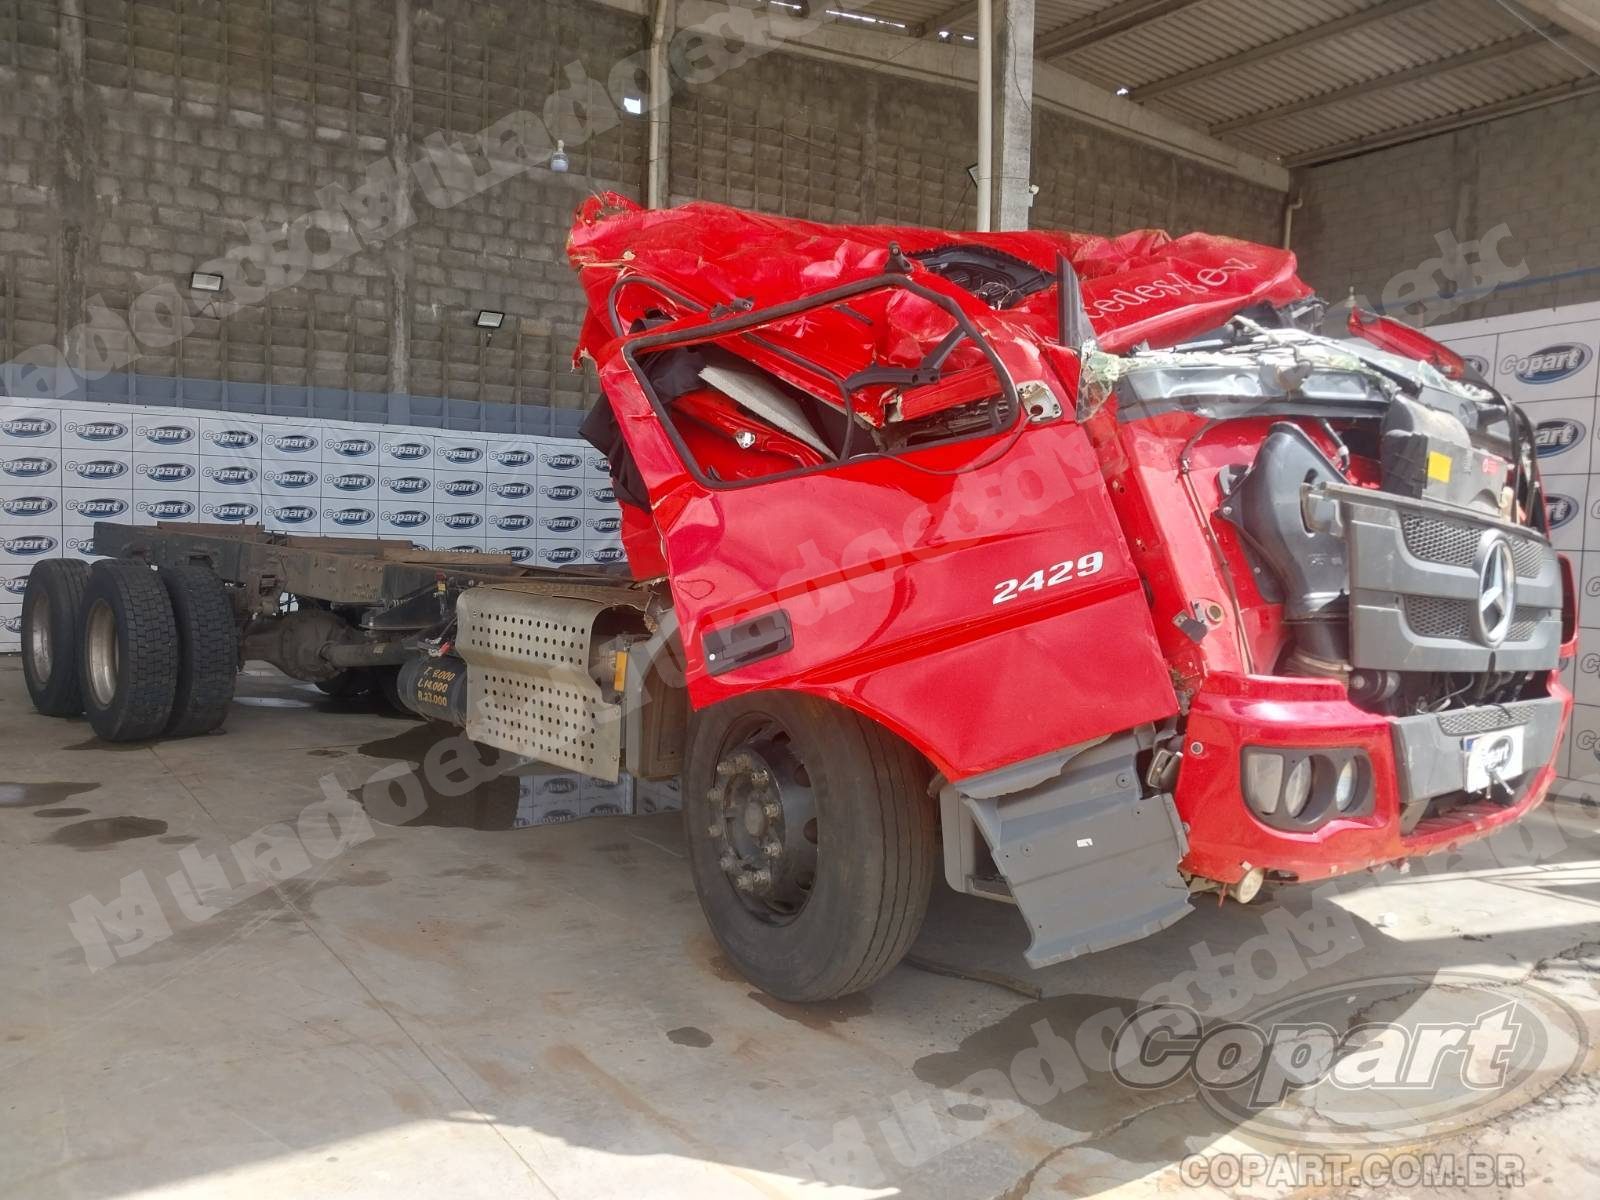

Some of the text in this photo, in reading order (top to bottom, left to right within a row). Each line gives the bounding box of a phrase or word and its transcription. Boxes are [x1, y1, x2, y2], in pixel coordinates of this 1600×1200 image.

[1500, 345, 1582, 378] Copart
[0, 420, 48, 433] opart
[65, 421, 121, 436] Copart
[136, 425, 188, 440] Copart
[202, 430, 251, 443] Copart
[1535, 423, 1575, 446] art
[264, 435, 312, 448] Copart
[324, 439, 368, 451] Copart
[382, 443, 425, 455] Copart
[437, 447, 477, 459] Copart
[489, 451, 528, 463] Copart
[540, 454, 577, 466] Copart
[587, 456, 609, 468] Cop
[0, 459, 49, 472] opart
[65, 461, 121, 473] Copart
[136, 463, 188, 477] Copart
[202, 467, 251, 480] Copart
[264, 471, 311, 484] Copart
[324, 474, 367, 486] Copart
[381, 477, 424, 489] Copart
[437, 480, 477, 492] Copart
[489, 483, 528, 495] Copart
[540, 486, 577, 498] Copart
[587, 488, 614, 499] Copa
[0, 499, 49, 512] opart
[65, 499, 121, 512] Copart
[136, 501, 188, 514] Copart
[202, 503, 251, 516] Copart
[264, 506, 311, 519] Copart
[323, 509, 367, 521] Copart
[381, 511, 424, 523] Copart
[436, 514, 477, 525] Copart
[489, 515, 528, 527] Copart
[540, 517, 577, 529] Copart
[66, 538, 94, 552] Cop
[538, 547, 577, 560] Copart
[585, 549, 623, 561] Copart
[992, 551, 1104, 605] 2429
